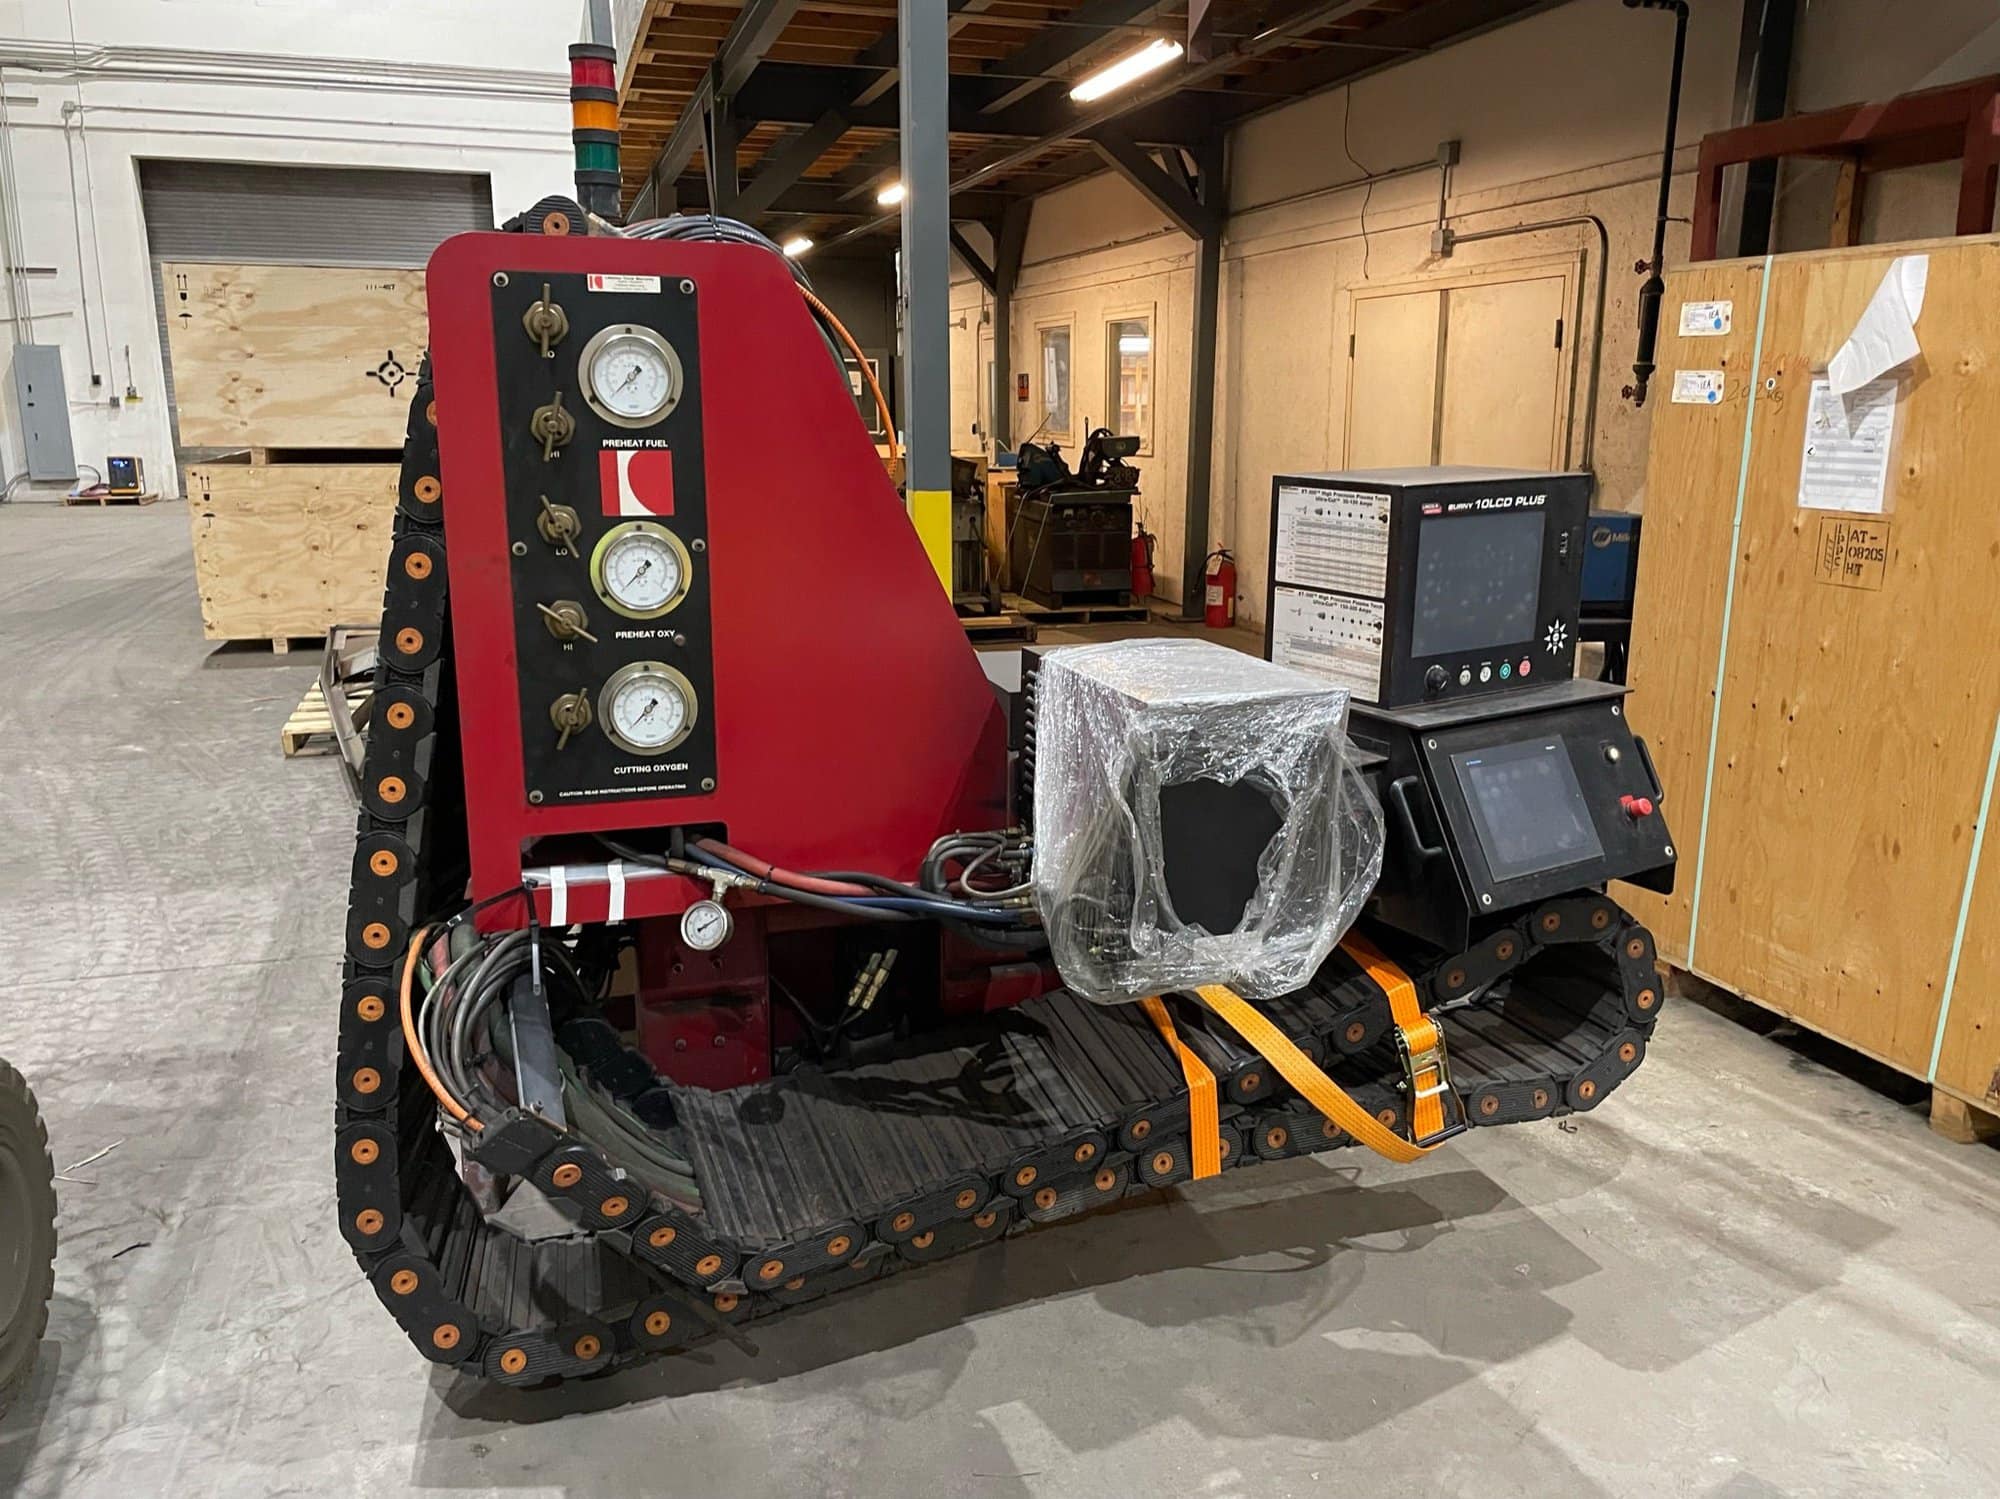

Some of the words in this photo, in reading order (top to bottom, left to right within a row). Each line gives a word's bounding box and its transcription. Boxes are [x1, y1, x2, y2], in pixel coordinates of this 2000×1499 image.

[602, 439, 644, 448] PREHEAT
[645, 439, 668, 448] FUEL
[1447, 502, 1473, 512] BURNY
[1474, 496, 1513, 510] 10LCD
[1515, 494, 1548, 507] PLUS
[555, 547, 568, 556] LO
[615, 630, 656, 639] PREHEAT
[656, 629, 676, 638] OXY
[563, 643, 573, 651] HI
[613, 764, 652, 775] CUTTING
[652, 762, 689, 773] OXYGEN
